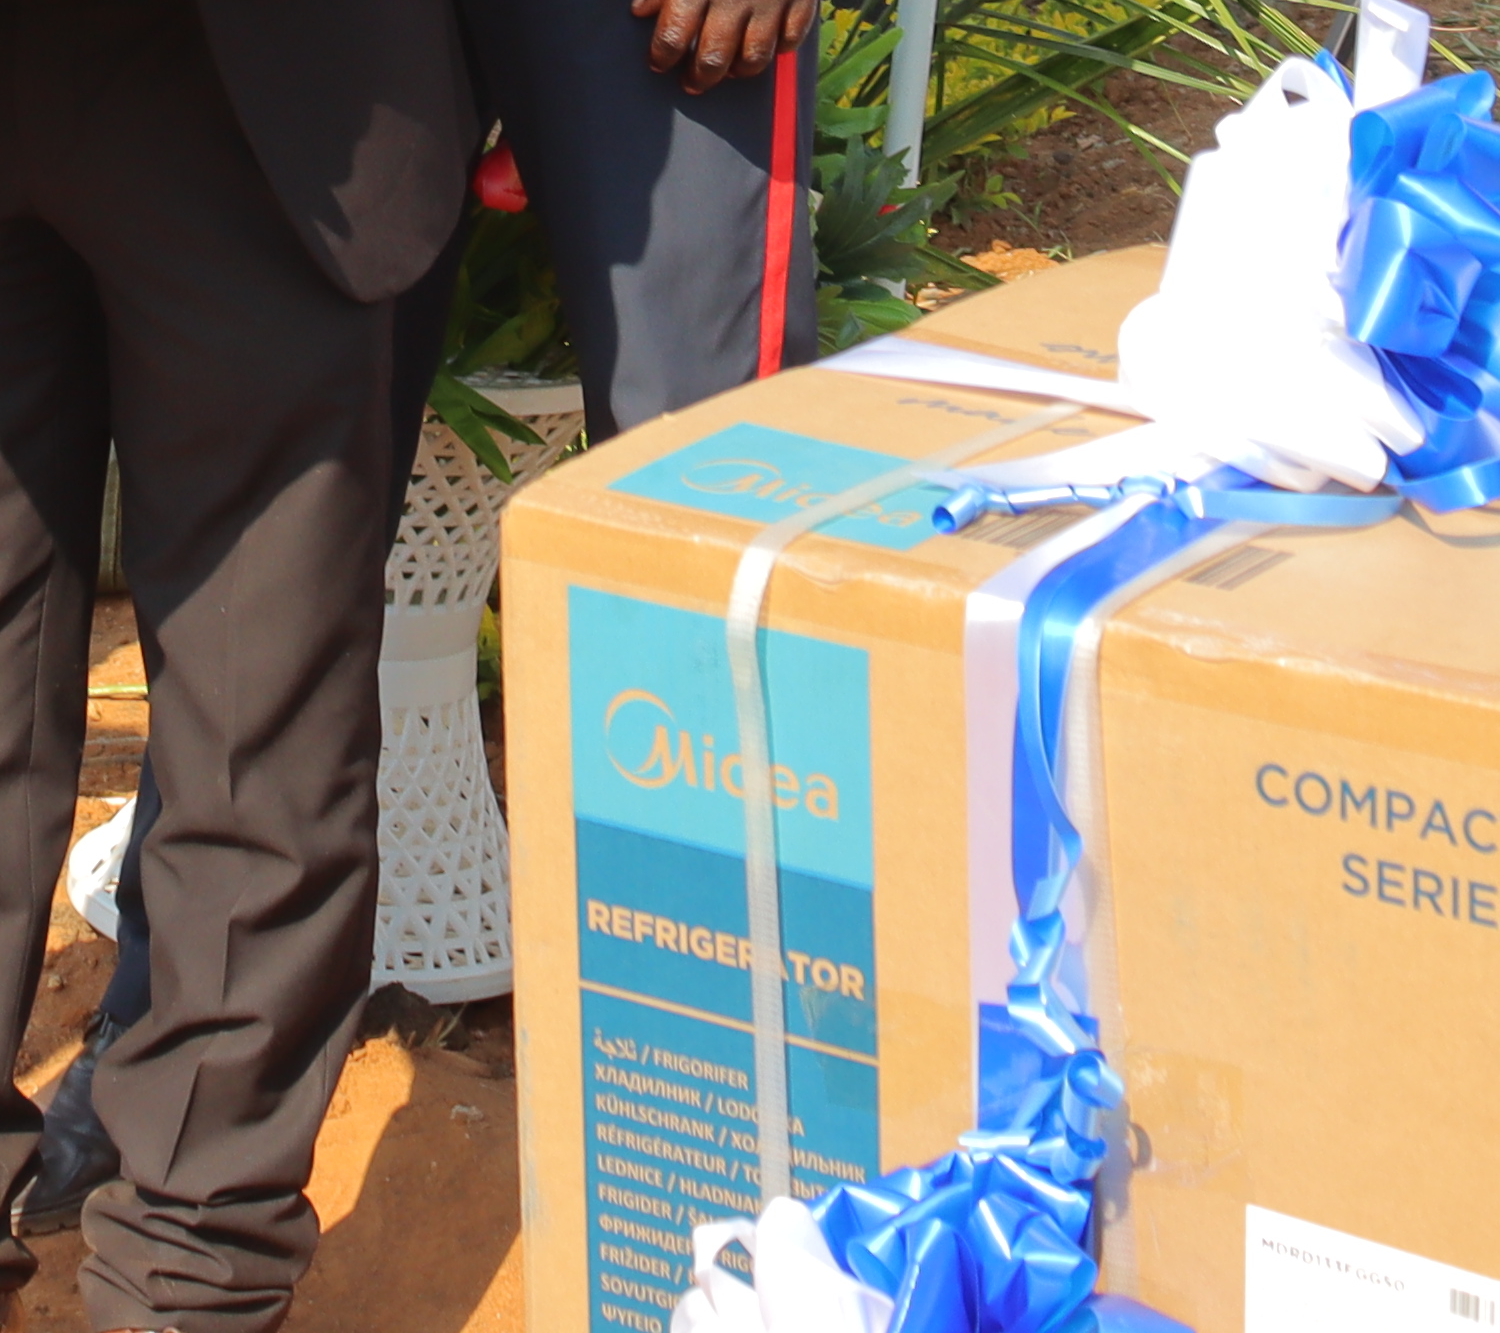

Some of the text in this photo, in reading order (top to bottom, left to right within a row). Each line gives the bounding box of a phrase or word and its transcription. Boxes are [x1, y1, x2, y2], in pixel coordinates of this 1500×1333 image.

[587, 899, 865, 1000] REFRIGERTOR
[653, 1049, 749, 1091] FRIGORIFER
[595, 1092, 715, 1142] KÜHLSCHRANK
[596, 1122, 727, 1175] RÉFRIGÉRATEUR
[597, 1153, 663, 1188] LEDNICE
[598, 1182, 672, 1220] FRIGIDER
[600, 1242, 671, 1280] FRIŽIDER
